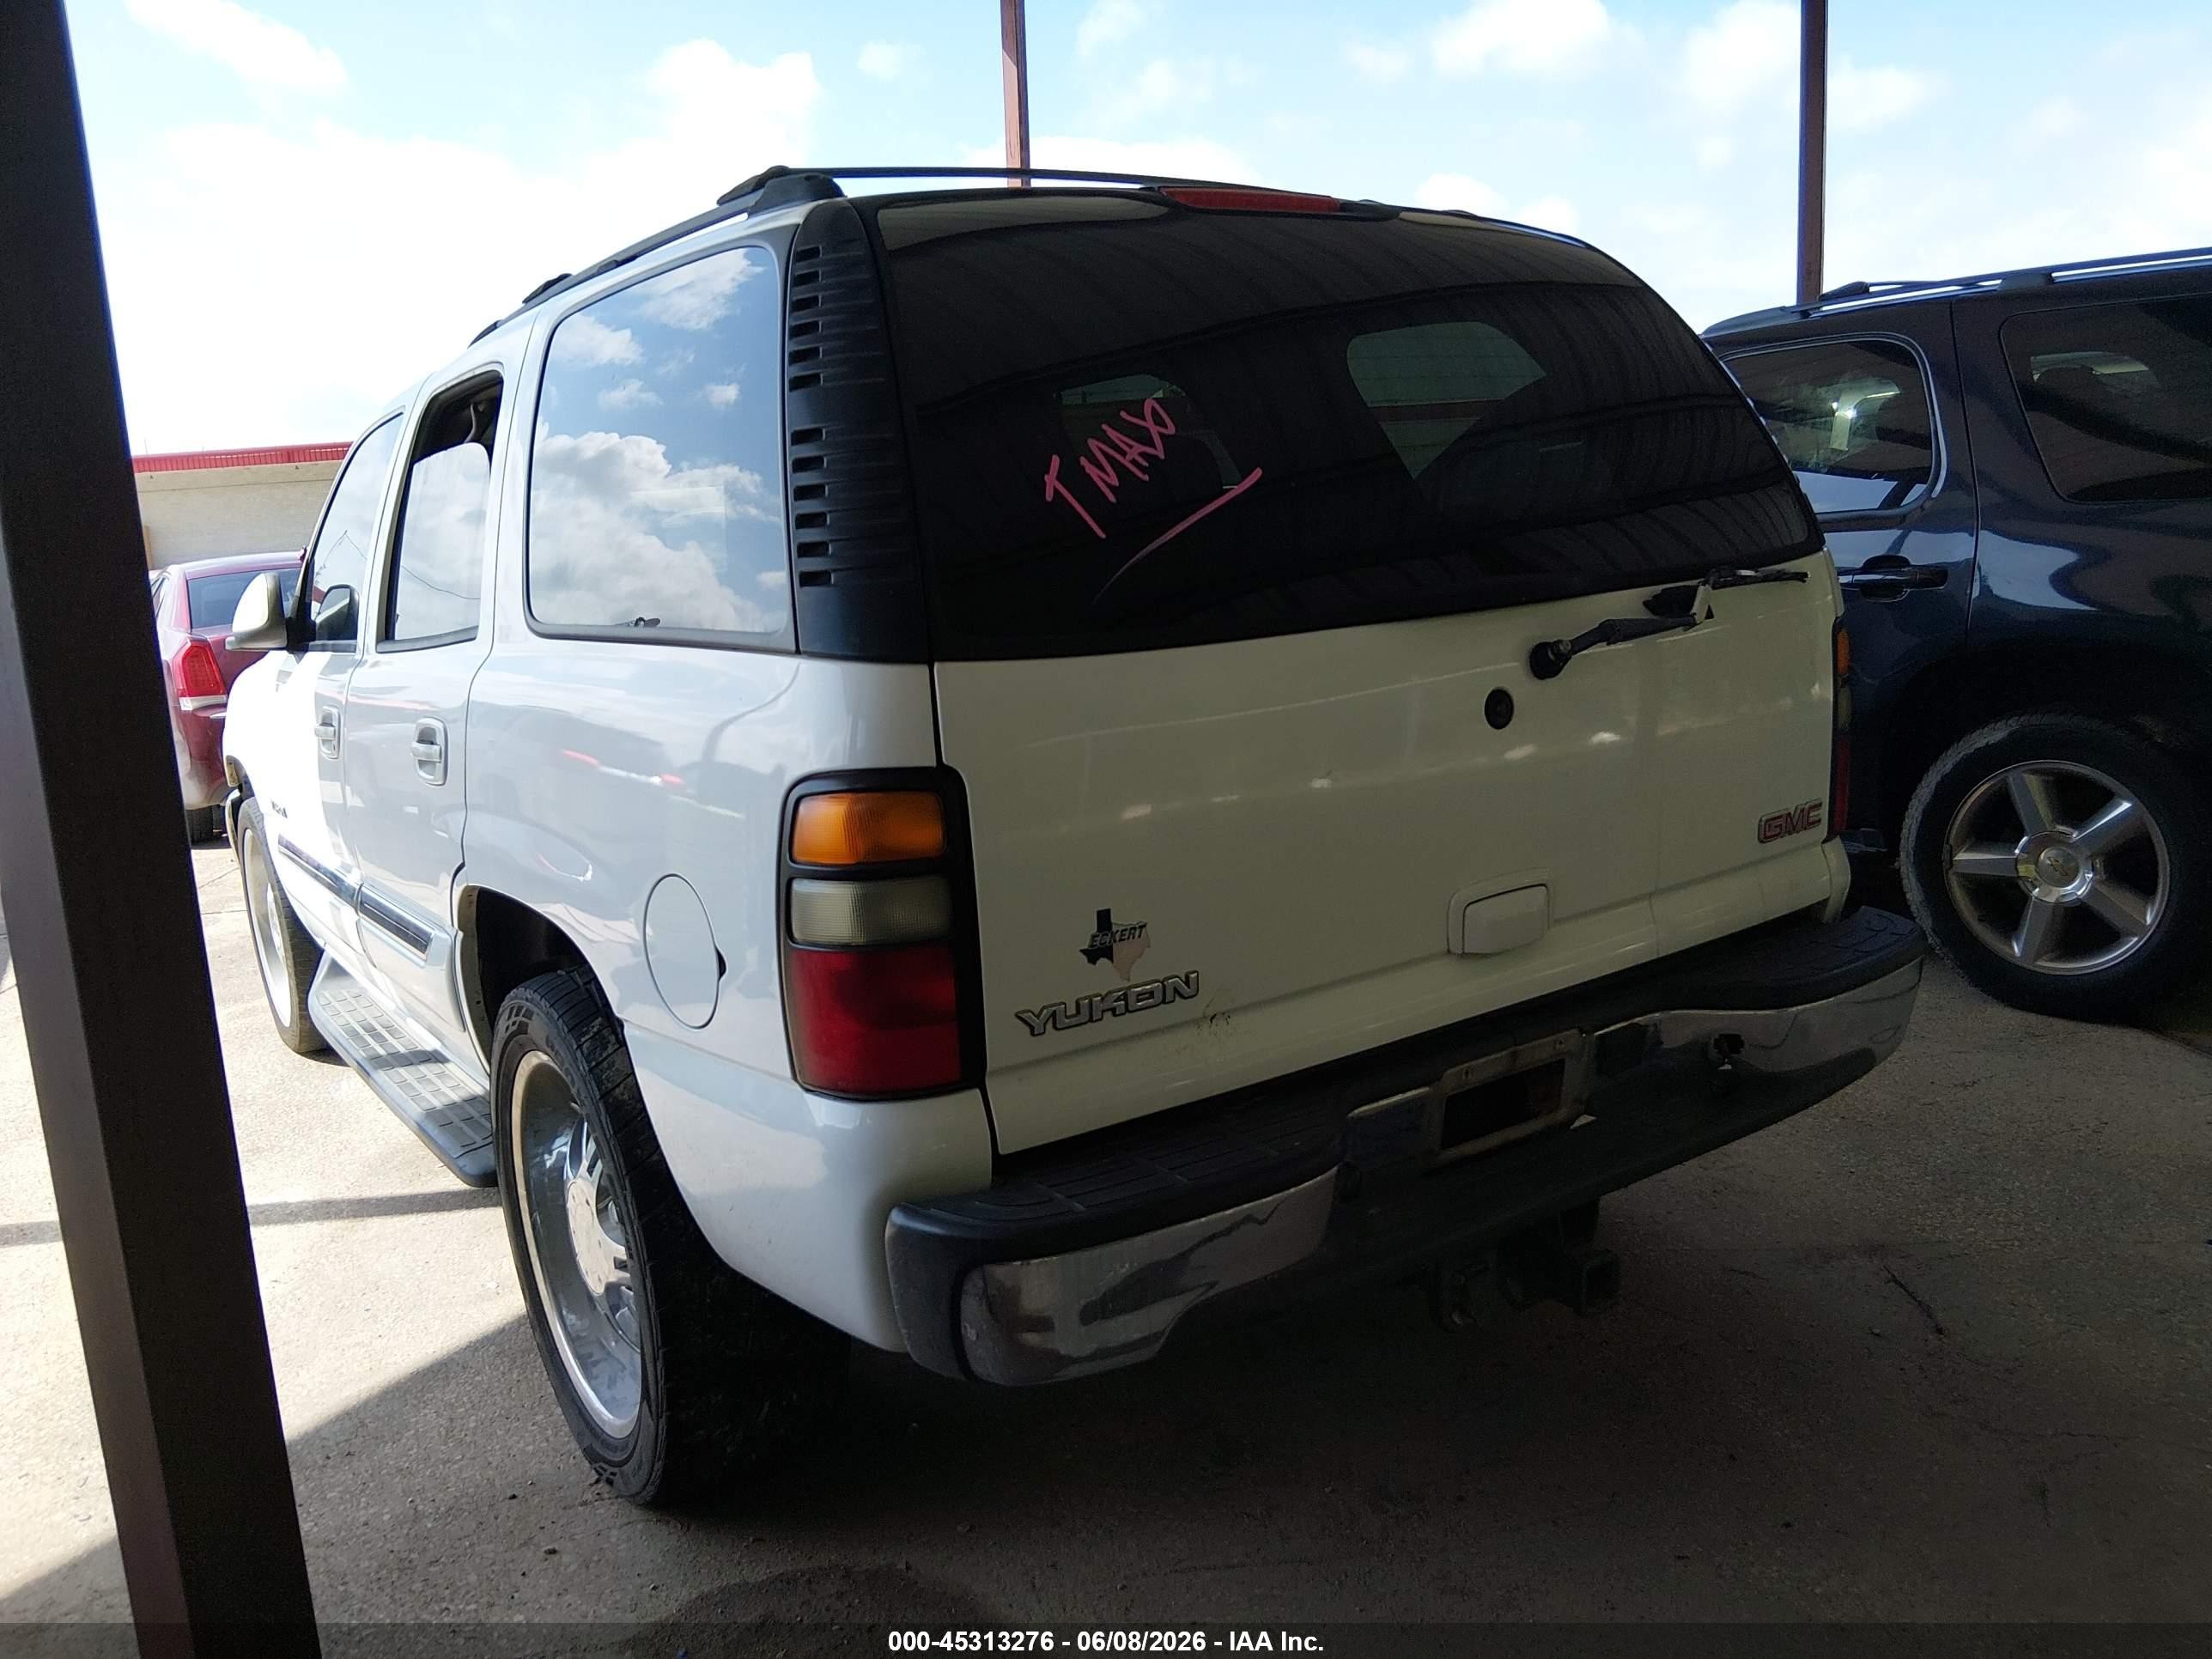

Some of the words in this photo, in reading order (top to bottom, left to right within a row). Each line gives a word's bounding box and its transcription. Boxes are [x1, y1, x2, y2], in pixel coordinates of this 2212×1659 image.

[1758, 799, 1823, 843] GMC
[1087, 923, 1148, 949] ECKERT
[1015, 969, 1200, 1036] YUKON
